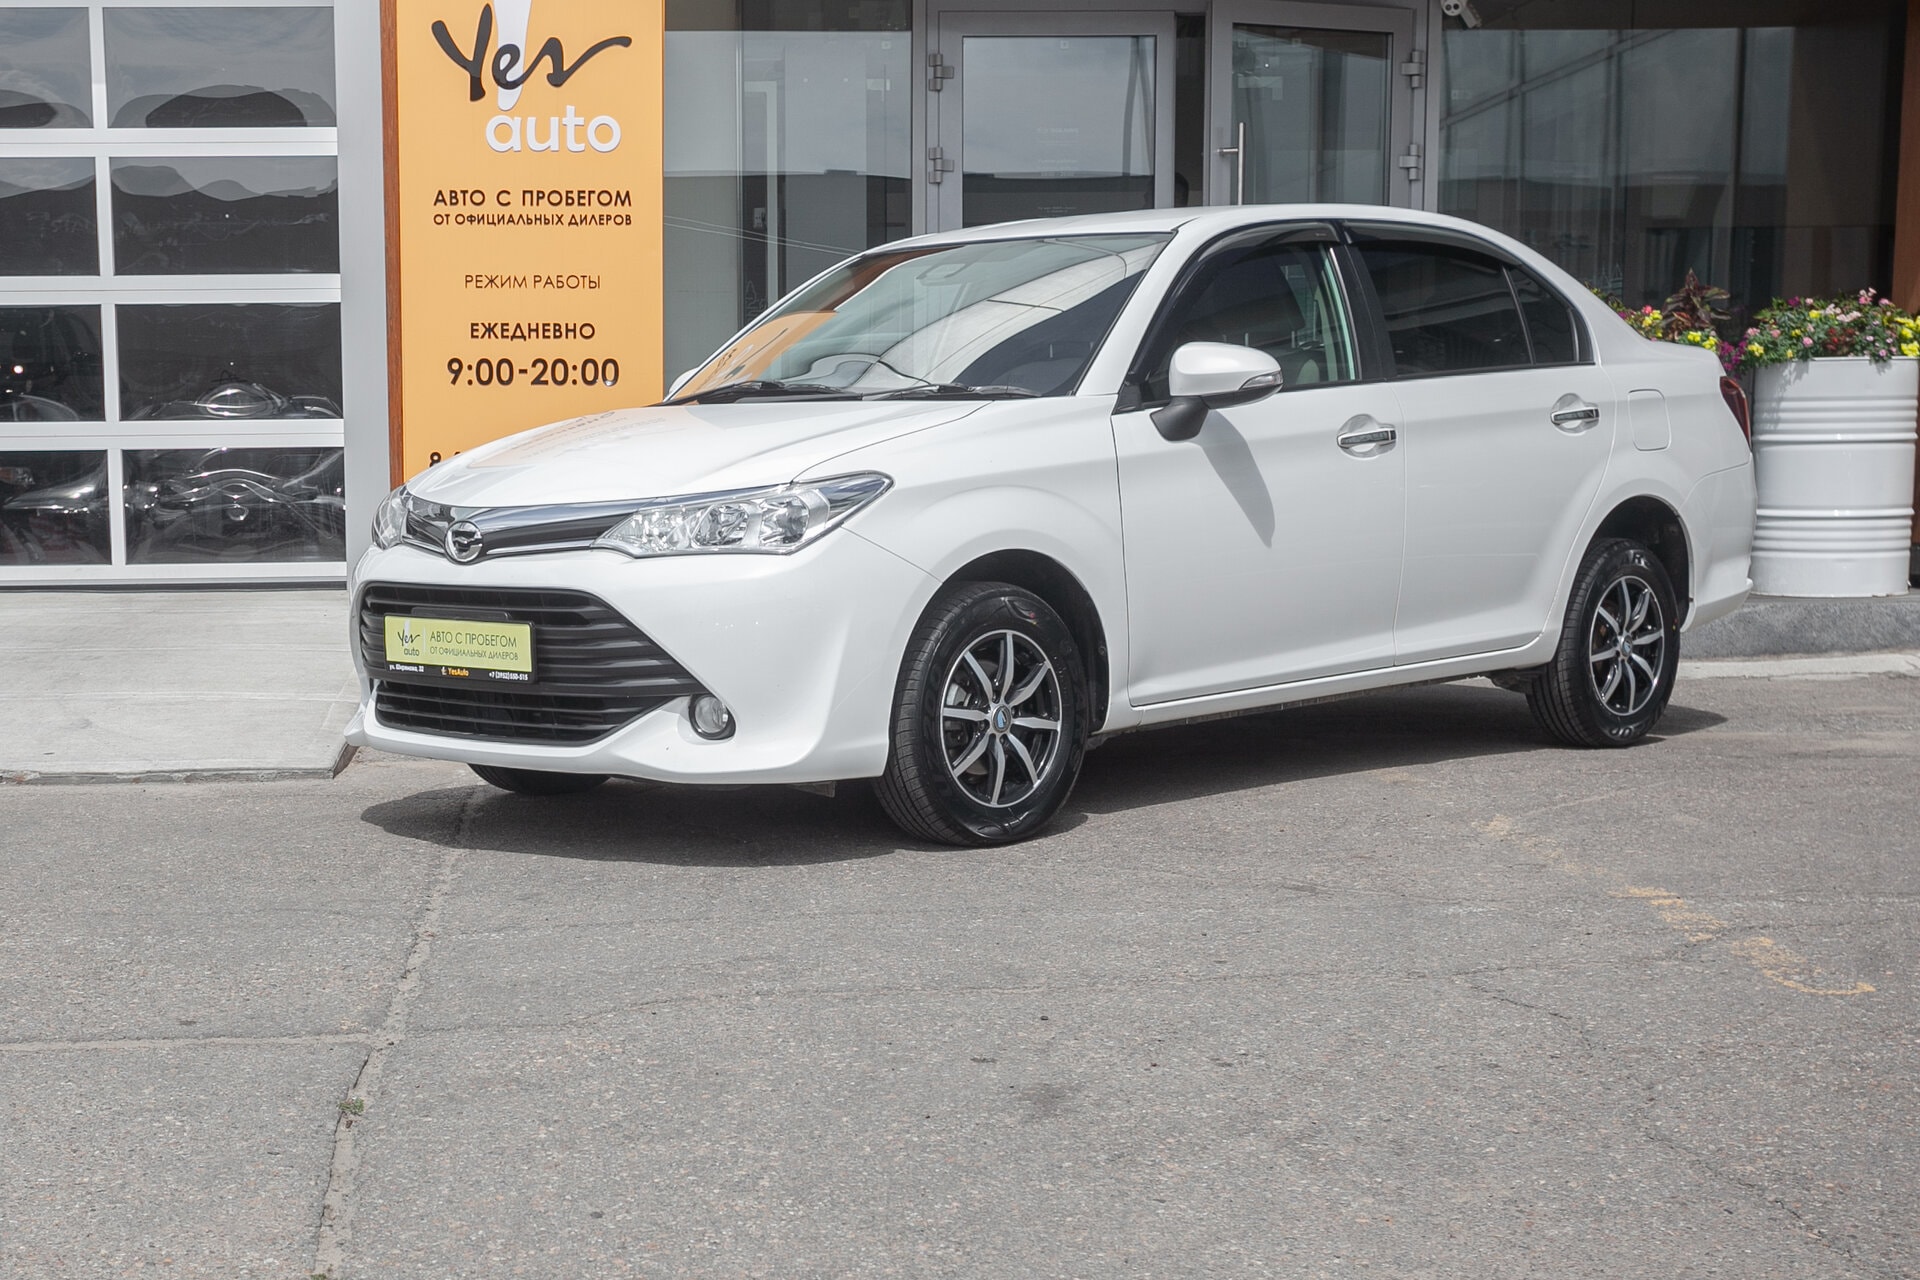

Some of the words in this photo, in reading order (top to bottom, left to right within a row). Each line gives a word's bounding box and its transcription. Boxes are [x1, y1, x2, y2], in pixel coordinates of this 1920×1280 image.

[431, 3, 632, 102] Yes
[485, 105, 621, 153] auto
[433, 190, 485, 207] АВТО
[496, 190, 511, 207] С
[522, 190, 632, 207] ПРОБЕГОМ
[433, 213, 450, 226] ОТ
[455, 213, 564, 227] ОФИЦИАЛЬНЫХ
[568, 214, 632, 227] ДИЛЕРОВ
[464, 275, 528, 289] РЕЖИМ
[533, 275, 601, 289] РАБОТЫ
[470, 322, 595, 341] ЕЖЕДНЕВНО
[447, 358, 620, 386] 9:00-20:00
[430, 631, 452, 644] АВТО
[455, 632, 462, 644] С
[465, 633, 517, 648] ПРОБЕГОМ
[404, 647, 420, 657] auto
[430, 646, 438, 655] ОТ
[439, 646, 487, 659] ОФИЦИАЛЬНЫХ
[488, 651, 518, 660] ДИЛЕРОВ
[448, 667, 469, 677] YesAuto
